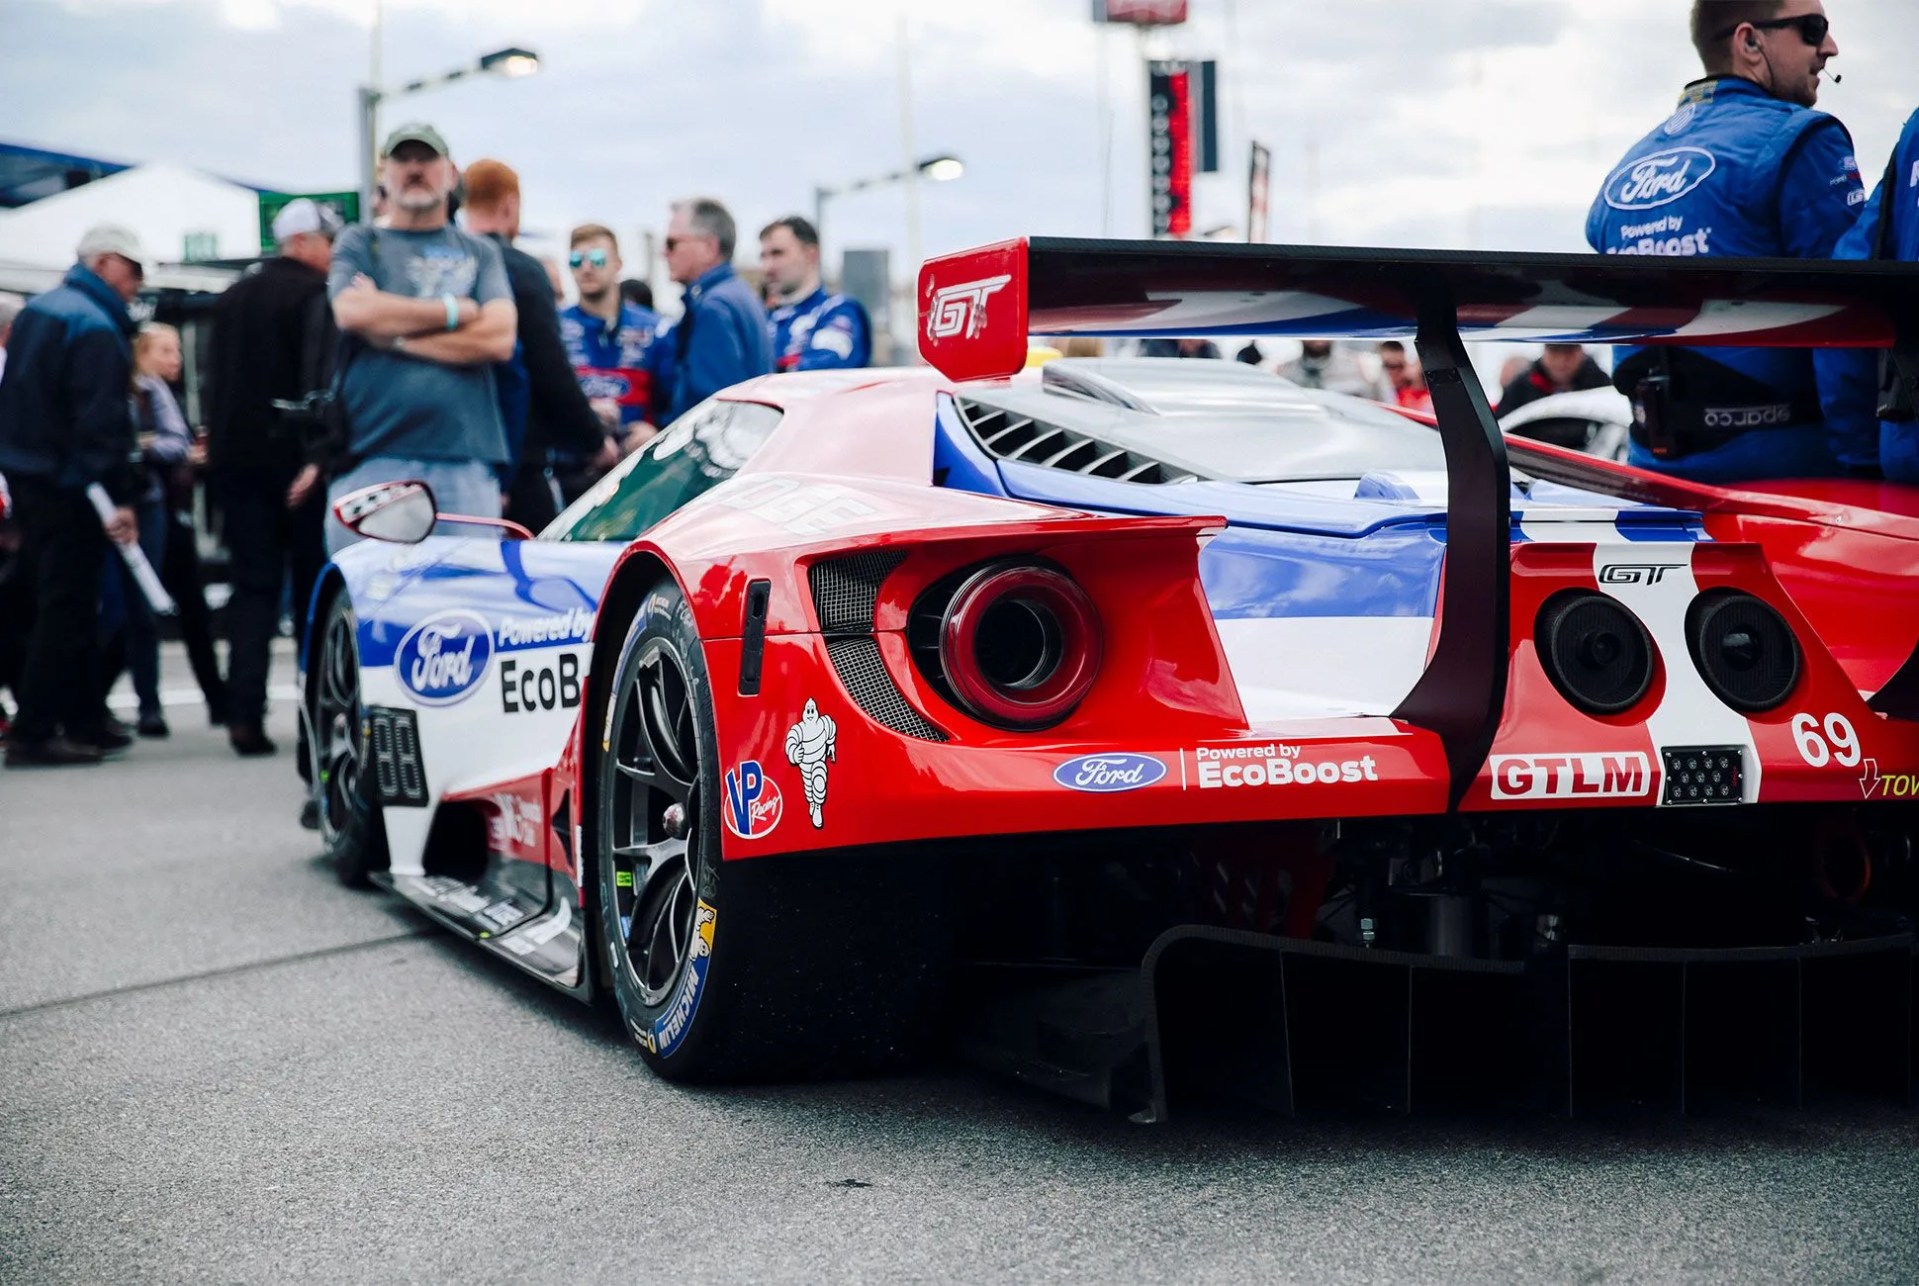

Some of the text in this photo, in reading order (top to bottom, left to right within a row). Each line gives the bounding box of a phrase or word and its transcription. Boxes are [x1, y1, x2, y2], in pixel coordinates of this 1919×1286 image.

[1619, 155, 1692, 203] Ford
[1620, 215, 1683, 240] Powered by
[927, 274, 1012, 340] GT
[1599, 563, 1689, 586] GT
[498, 608, 574, 647] Powered
[411, 623, 477, 691] Ford
[1196, 743, 1301, 761] Powered by
[1791, 712, 1861, 768] 69
[1075, 758, 1144, 785] Ford
[1197, 755, 1379, 789] EcoBoost
[1497, 756, 1646, 796] GTLM
[725, 759, 764, 836] VP
[751, 795, 781, 826] Racing
[658, 965, 700, 1050] MICHELIN
